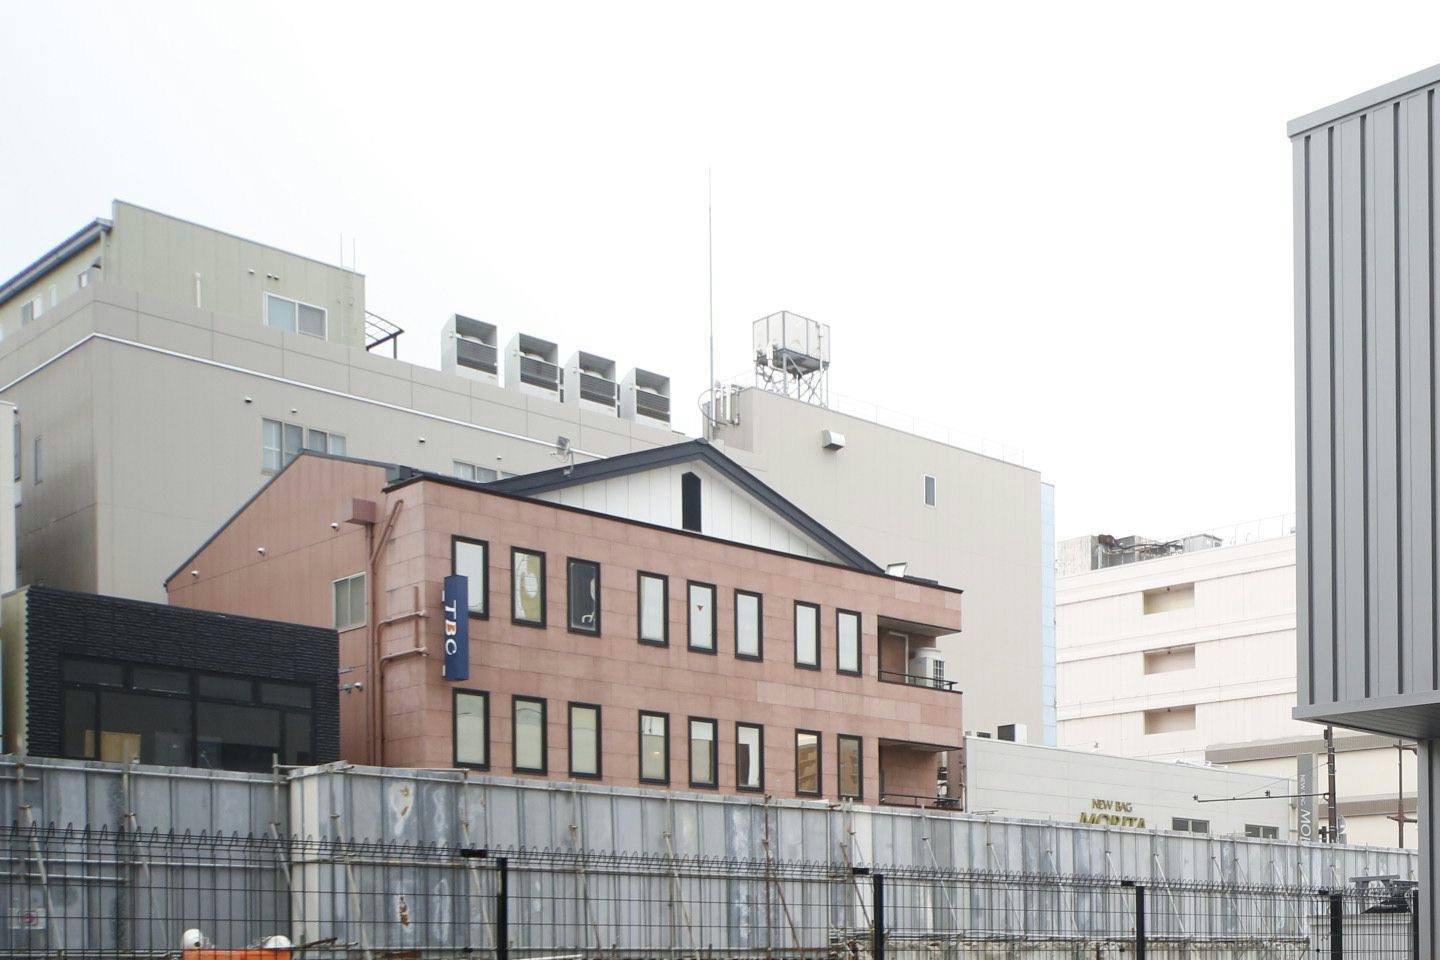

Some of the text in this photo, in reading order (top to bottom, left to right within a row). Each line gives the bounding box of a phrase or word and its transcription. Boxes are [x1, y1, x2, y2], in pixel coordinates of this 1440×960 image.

[445, 600, 457, 656] TBC
[1092, 798, 1133, 813] NEW BAG
